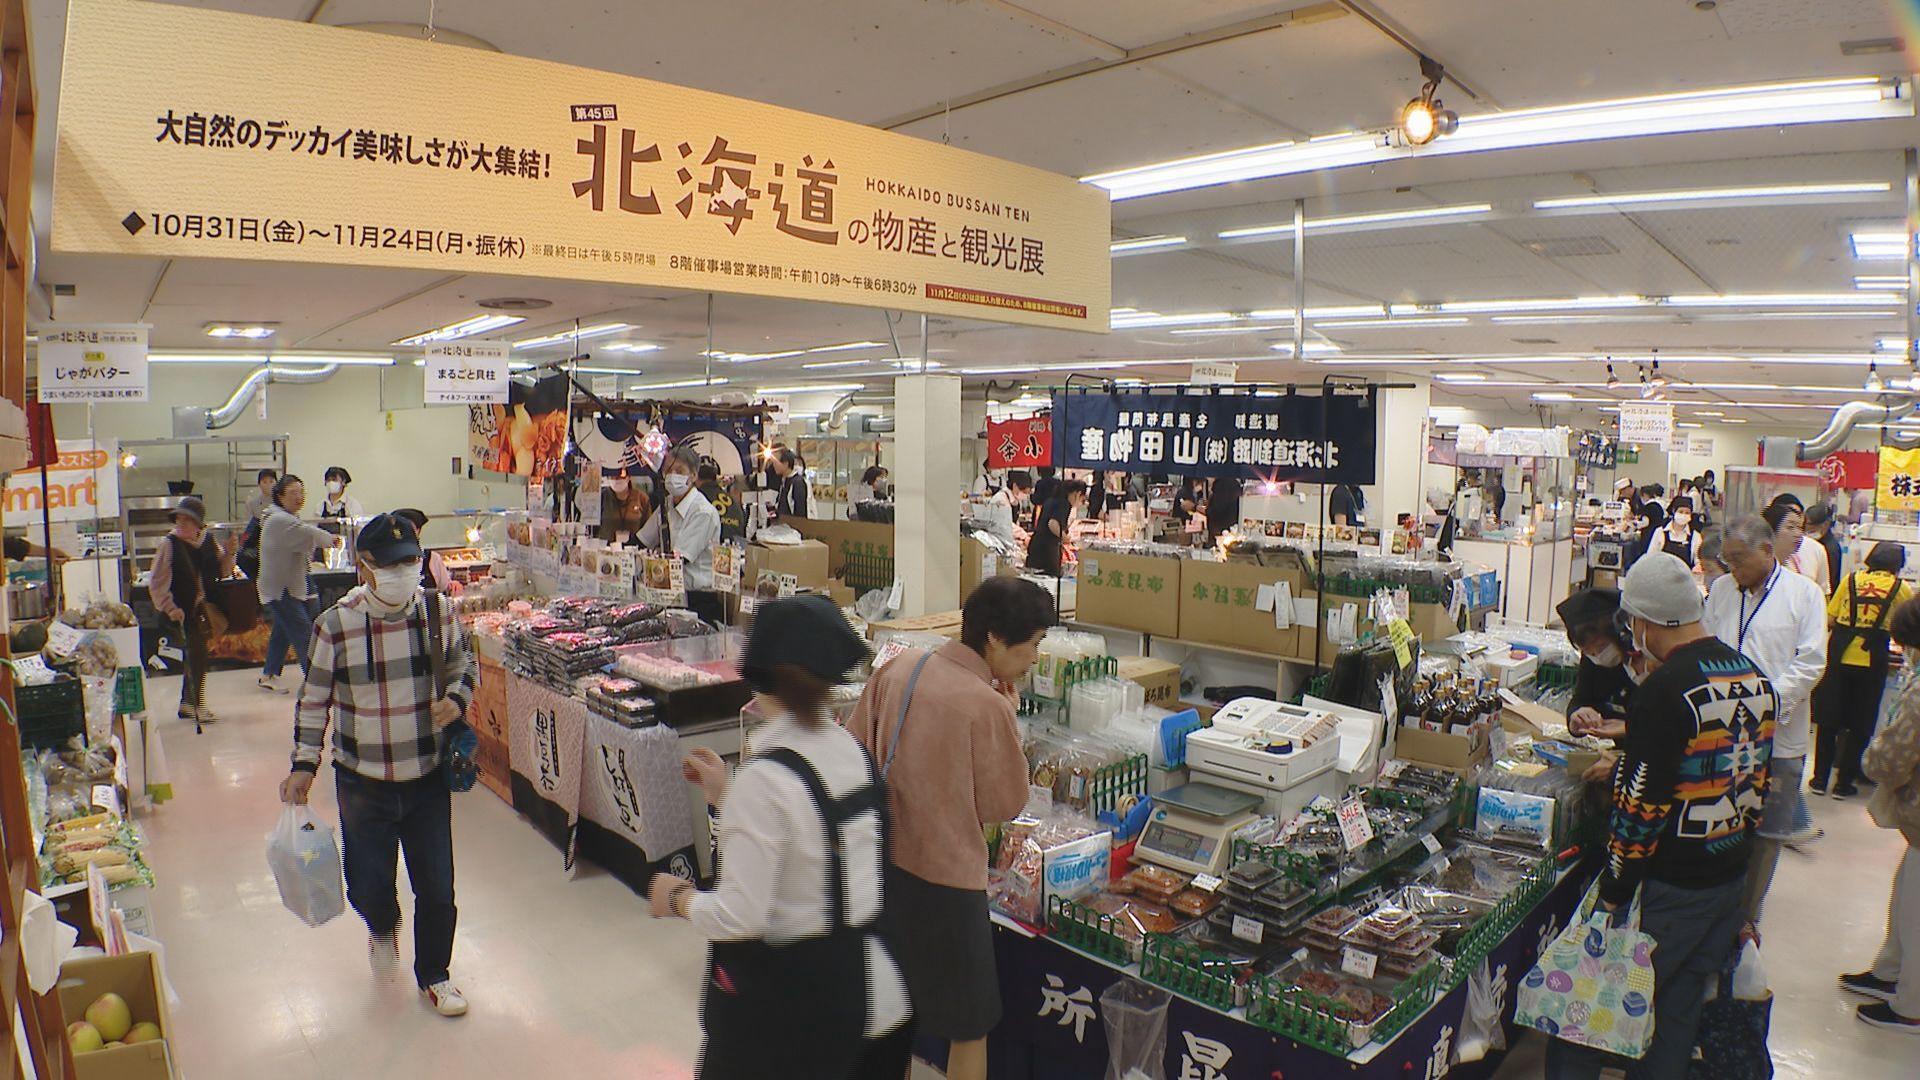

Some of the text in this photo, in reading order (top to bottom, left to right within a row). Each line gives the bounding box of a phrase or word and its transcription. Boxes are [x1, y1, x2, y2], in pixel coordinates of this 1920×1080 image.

[574, 106, 616, 121] 第45回
[156, 110, 552, 180] 大自然のデッカイ美味しさが大集結!
[573, 124, 1045, 276] 北海道 の物産と観光展
[866, 176, 1031, 223] HOKKAIDO BUSSAN TEN
[56, 367, 130, 380] じゃがバター
[438, 369, 496, 381] まるごと貝柱
[1088, 569, 1164, 594] 名産昆布
[1341, 800, 1359, 821] SALE
[1037, 973, 1096, 1043] 所
